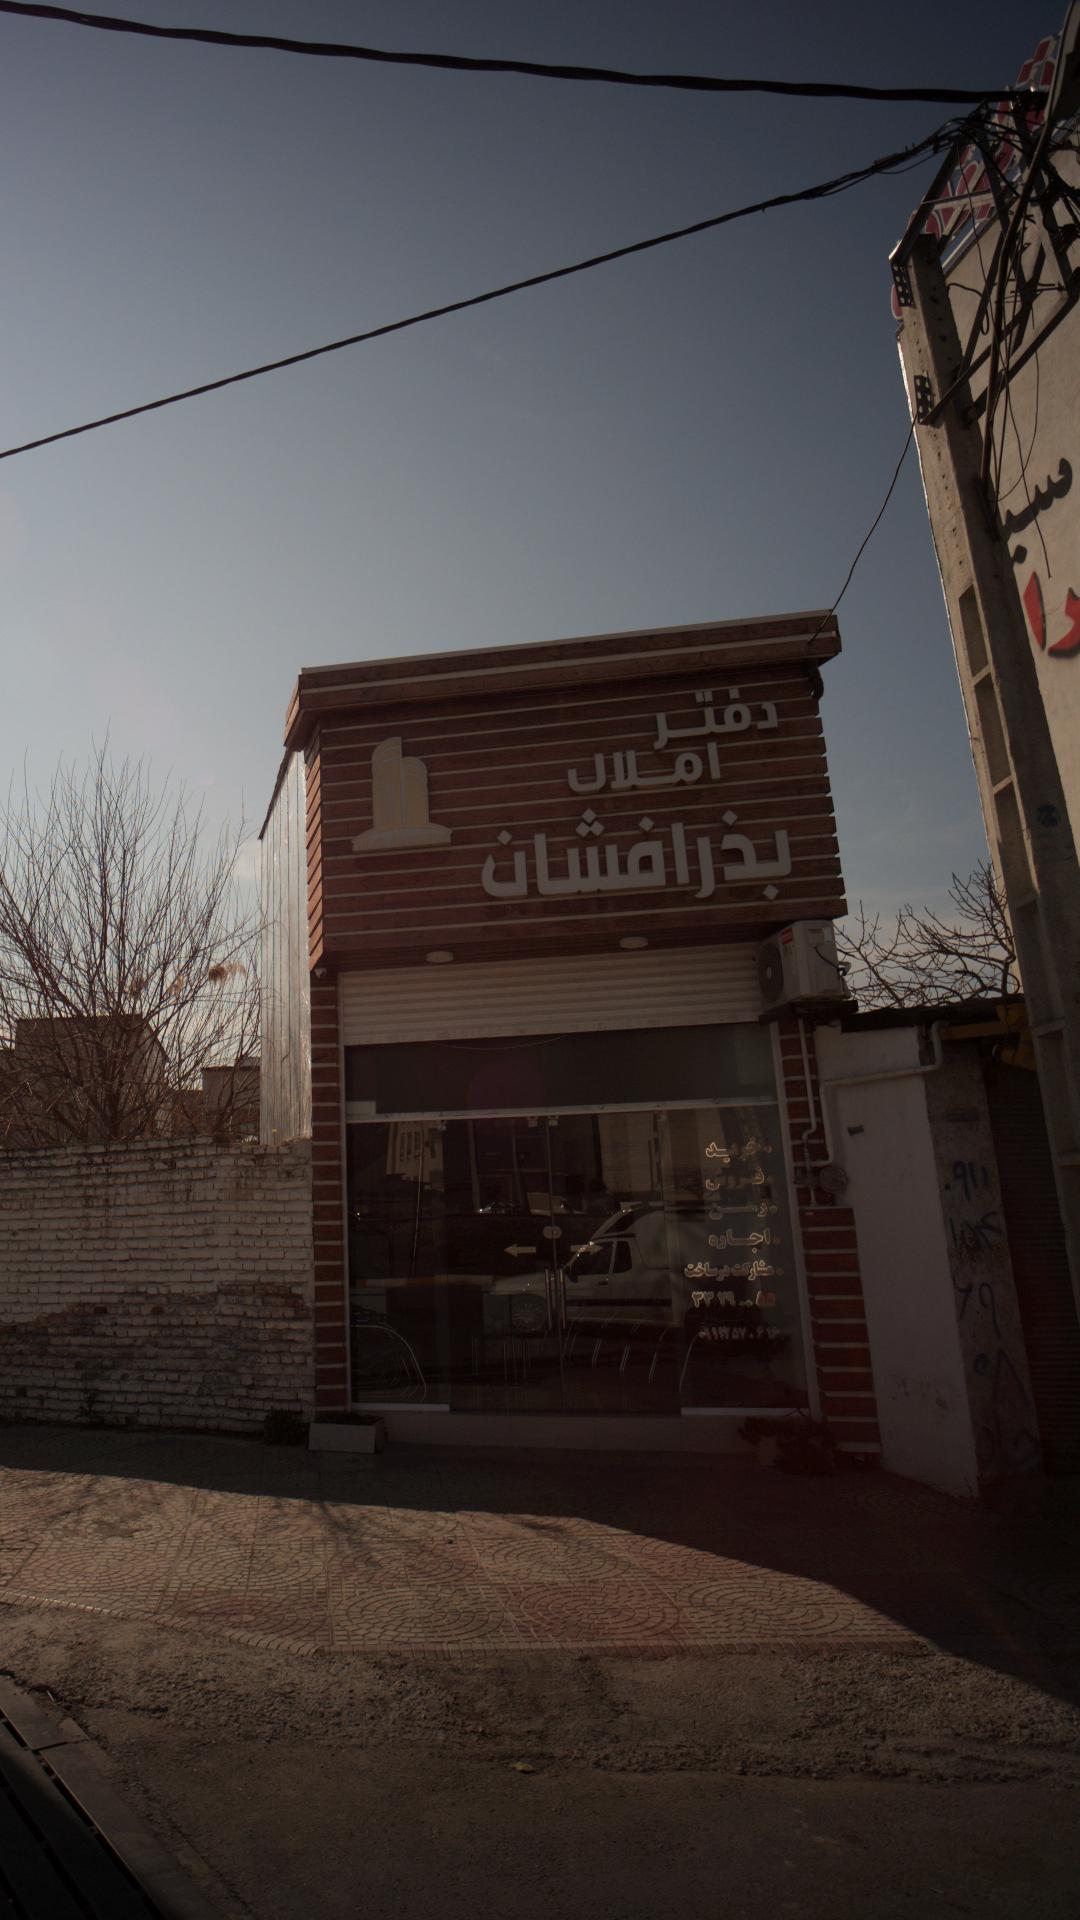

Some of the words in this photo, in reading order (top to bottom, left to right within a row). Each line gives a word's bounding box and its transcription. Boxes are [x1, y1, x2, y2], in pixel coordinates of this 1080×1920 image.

[653, 687, 779, 750] دفتر
[481, 807, 792, 901] بذرافشان
[707, 1226, 771, 1254] اجاره
